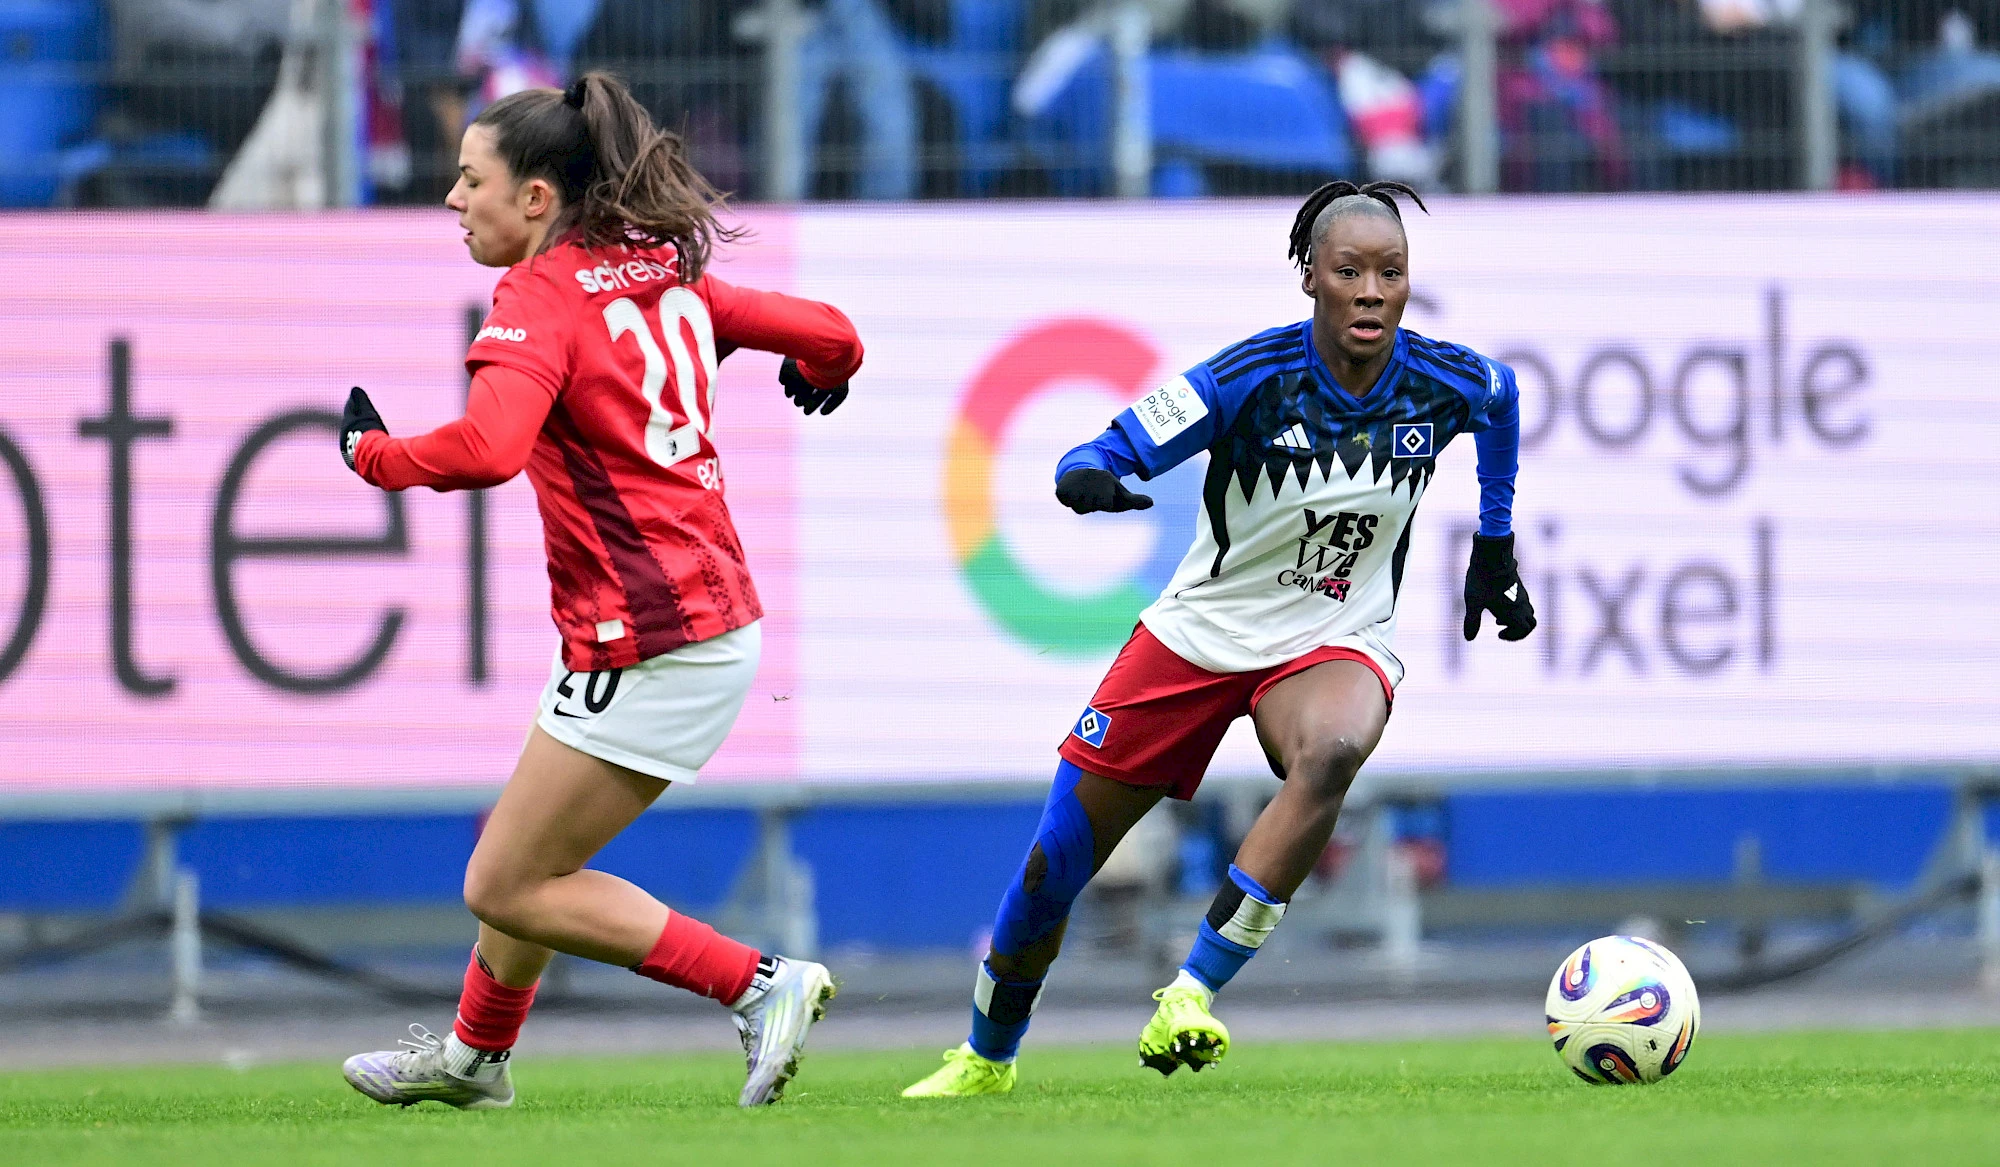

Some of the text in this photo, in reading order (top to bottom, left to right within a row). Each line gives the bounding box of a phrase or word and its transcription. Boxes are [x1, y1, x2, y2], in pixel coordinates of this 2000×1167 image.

[602, 286, 718, 468] 20
[1143, 395, 1171, 427] Pixel
[1404, 282, 1870, 498] oogle
[0, 300, 493, 696] tel
[1303, 508, 1379, 552] YES
[1296, 537, 1359, 578] We
